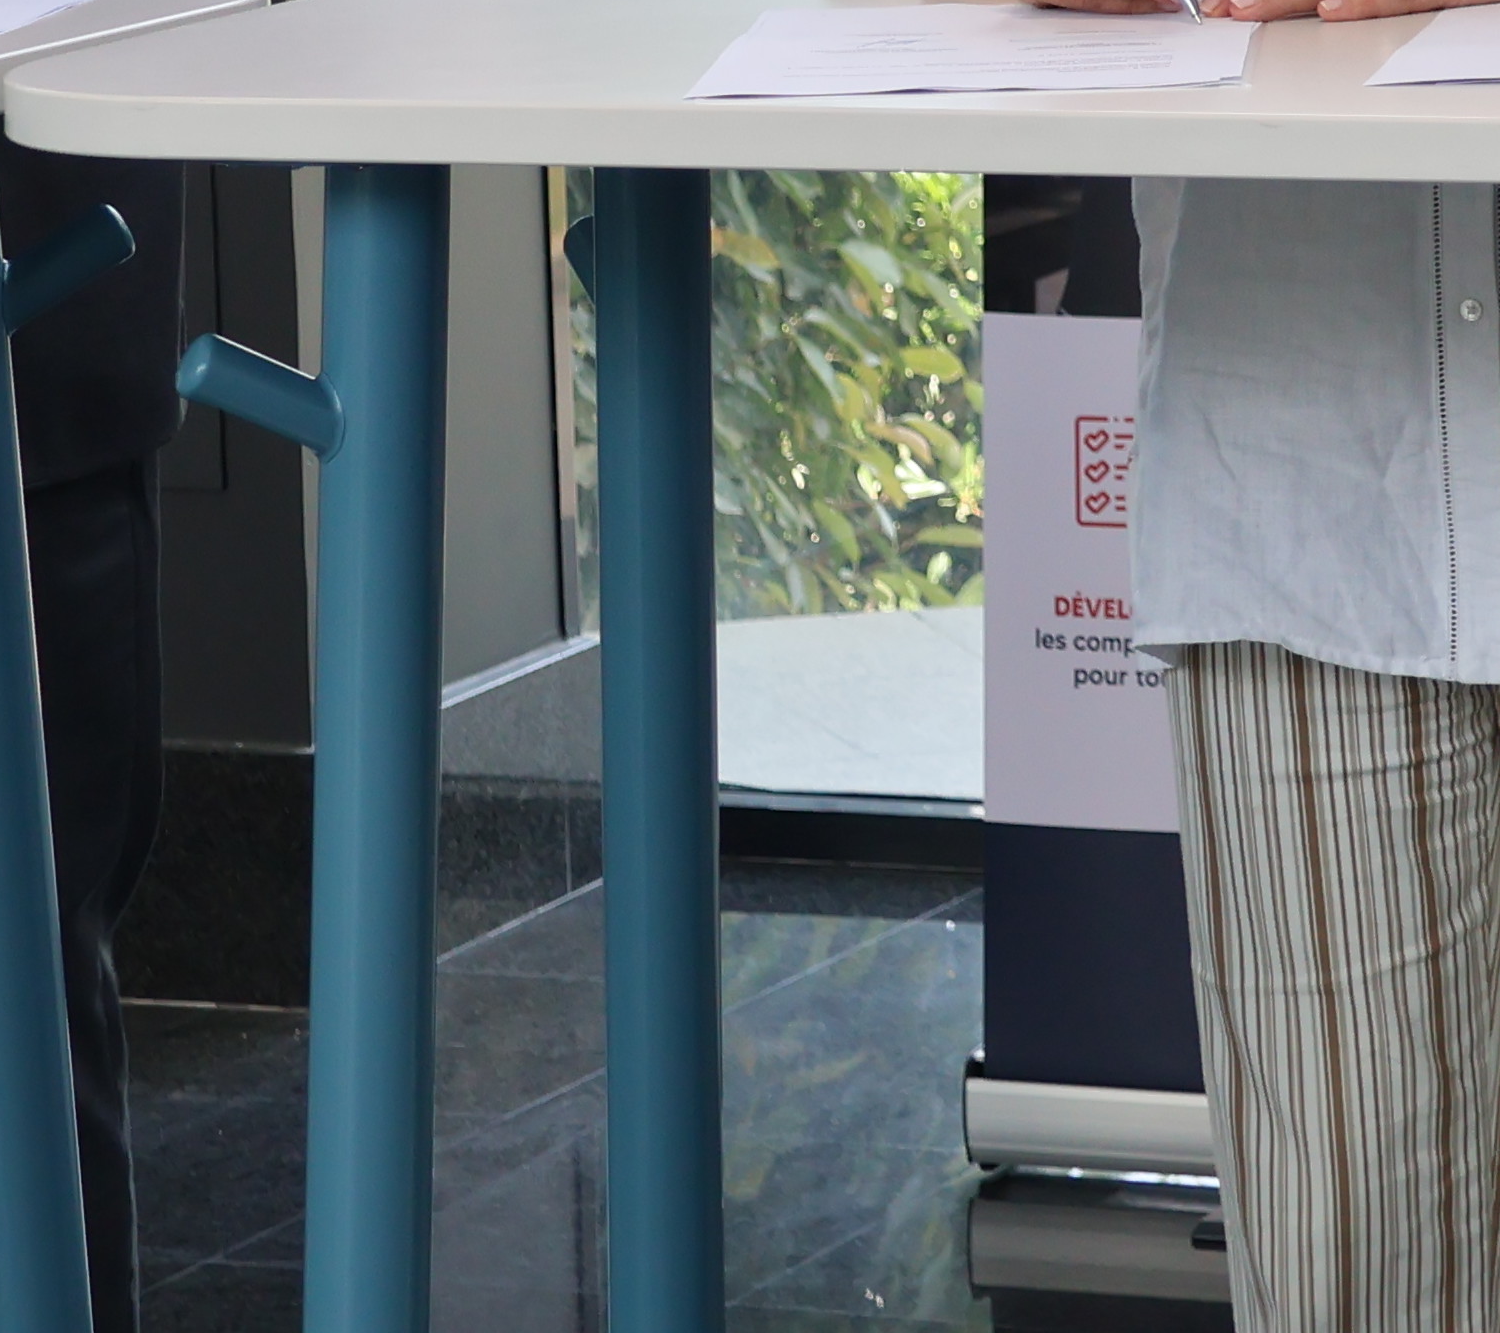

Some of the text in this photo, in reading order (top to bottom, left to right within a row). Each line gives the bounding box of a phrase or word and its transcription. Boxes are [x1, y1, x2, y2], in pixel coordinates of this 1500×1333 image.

[1053, 590, 1134, 620] DÉVEL
[1035, 627, 1136, 659] les comp
[1073, 668, 1129, 689] pour
